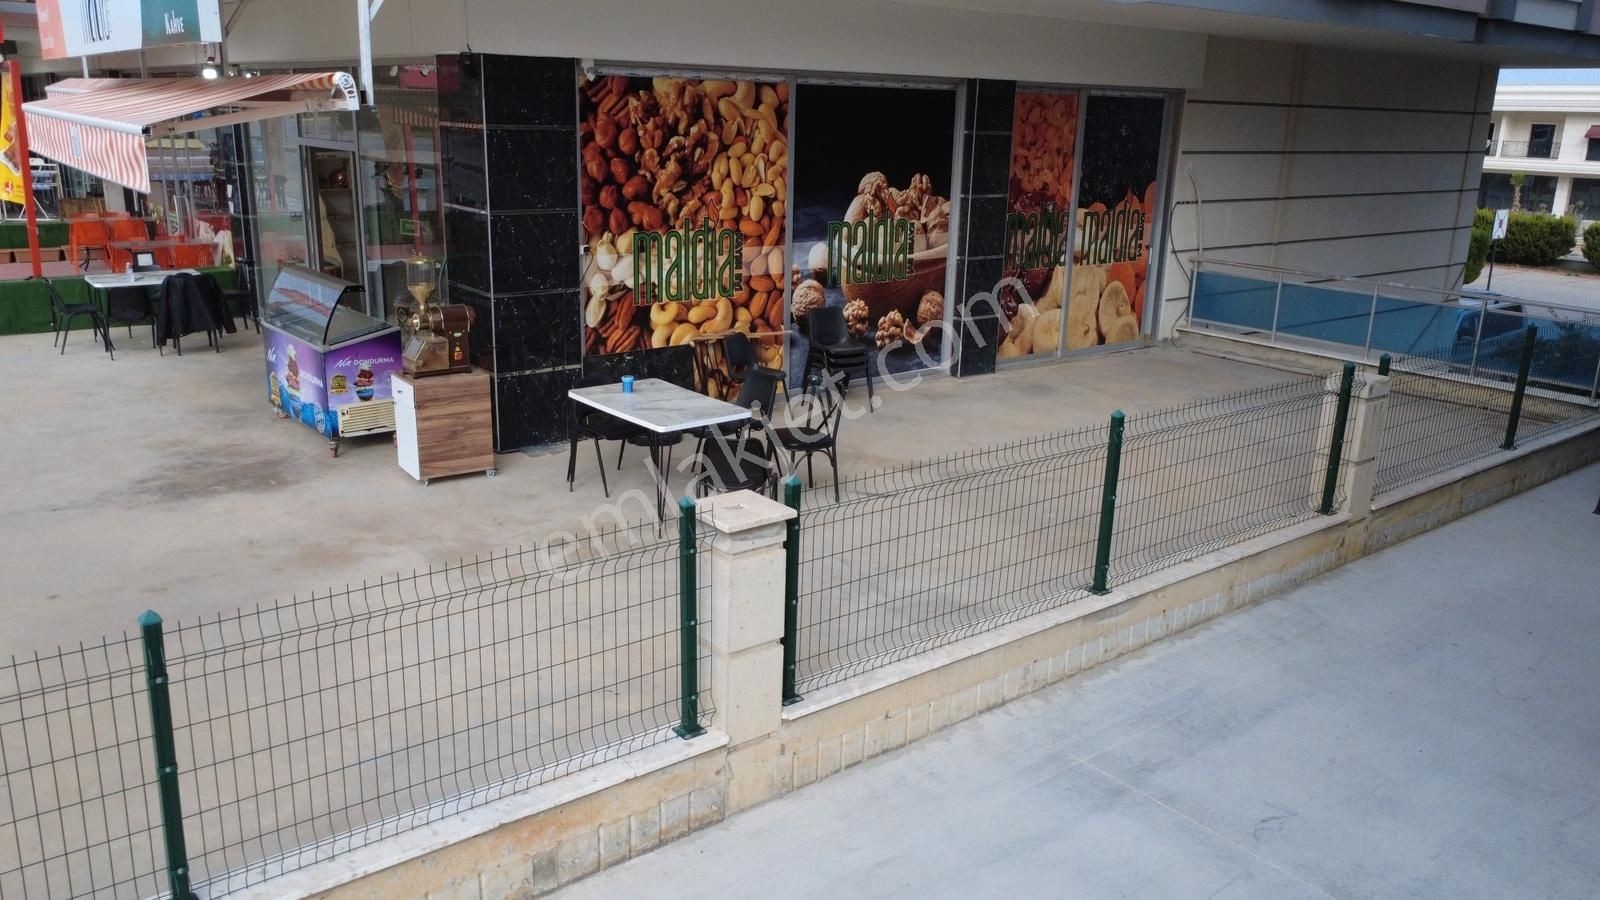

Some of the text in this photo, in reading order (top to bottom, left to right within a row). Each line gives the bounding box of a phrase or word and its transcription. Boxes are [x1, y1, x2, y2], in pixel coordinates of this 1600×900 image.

[633, 216, 735, 305] maldia
[827, 208, 909, 289] maldia
[353, 357, 394, 366] DONDURMA
